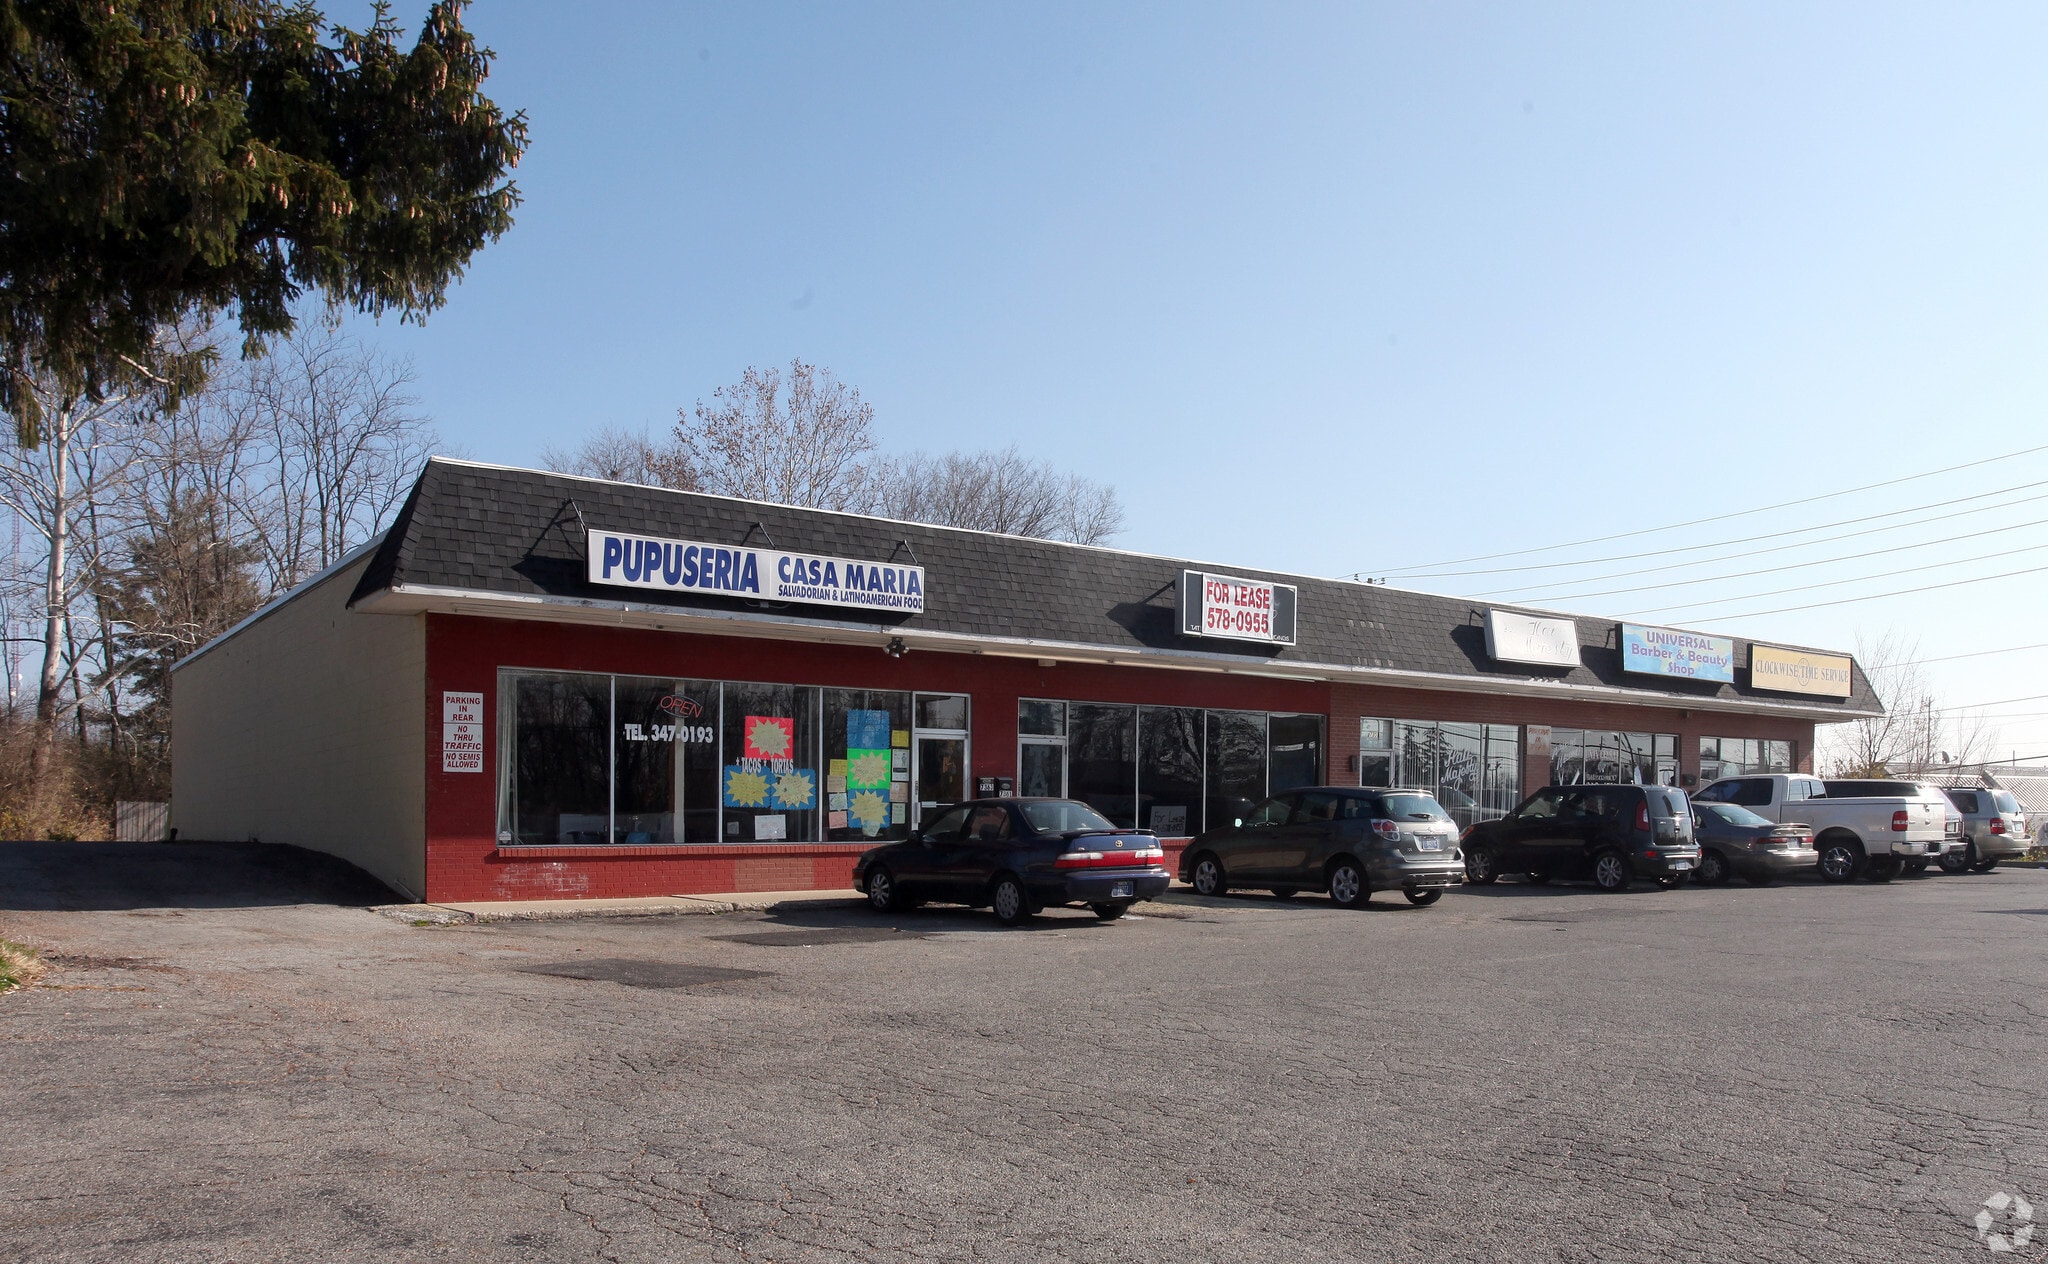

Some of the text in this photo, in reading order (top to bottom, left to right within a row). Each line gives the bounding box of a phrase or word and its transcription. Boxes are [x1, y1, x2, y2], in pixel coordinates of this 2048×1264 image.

[602, 536, 760, 594] PUPUSERIA
[778, 556, 922, 596] CASA MARIA
[778, 584, 922, 609] SALVADORIAN & LATINOAMERICAN FOOD
[1206, 581, 1270, 609] FOR LEASE
[1207, 607, 1269, 634] 578-0955
[1646, 631, 1713, 650] UNIVERSAL
[1631, 643, 1727, 667] Barber & Beauty
[1668, 662, 1694, 676] Shop
[1755, 659, 1849, 683] CLOCKWISE TIME SERVICE
[446, 696, 480, 704] PARKING
[660, 696, 703, 718] OPEN
[624, 723, 714, 743] TEL. 347-0193
[445, 742, 481, 750] TRAFFIC
[741, 757, 794, 773] TACOS TORTAS
[1441, 759, 1479, 791] Majesty
